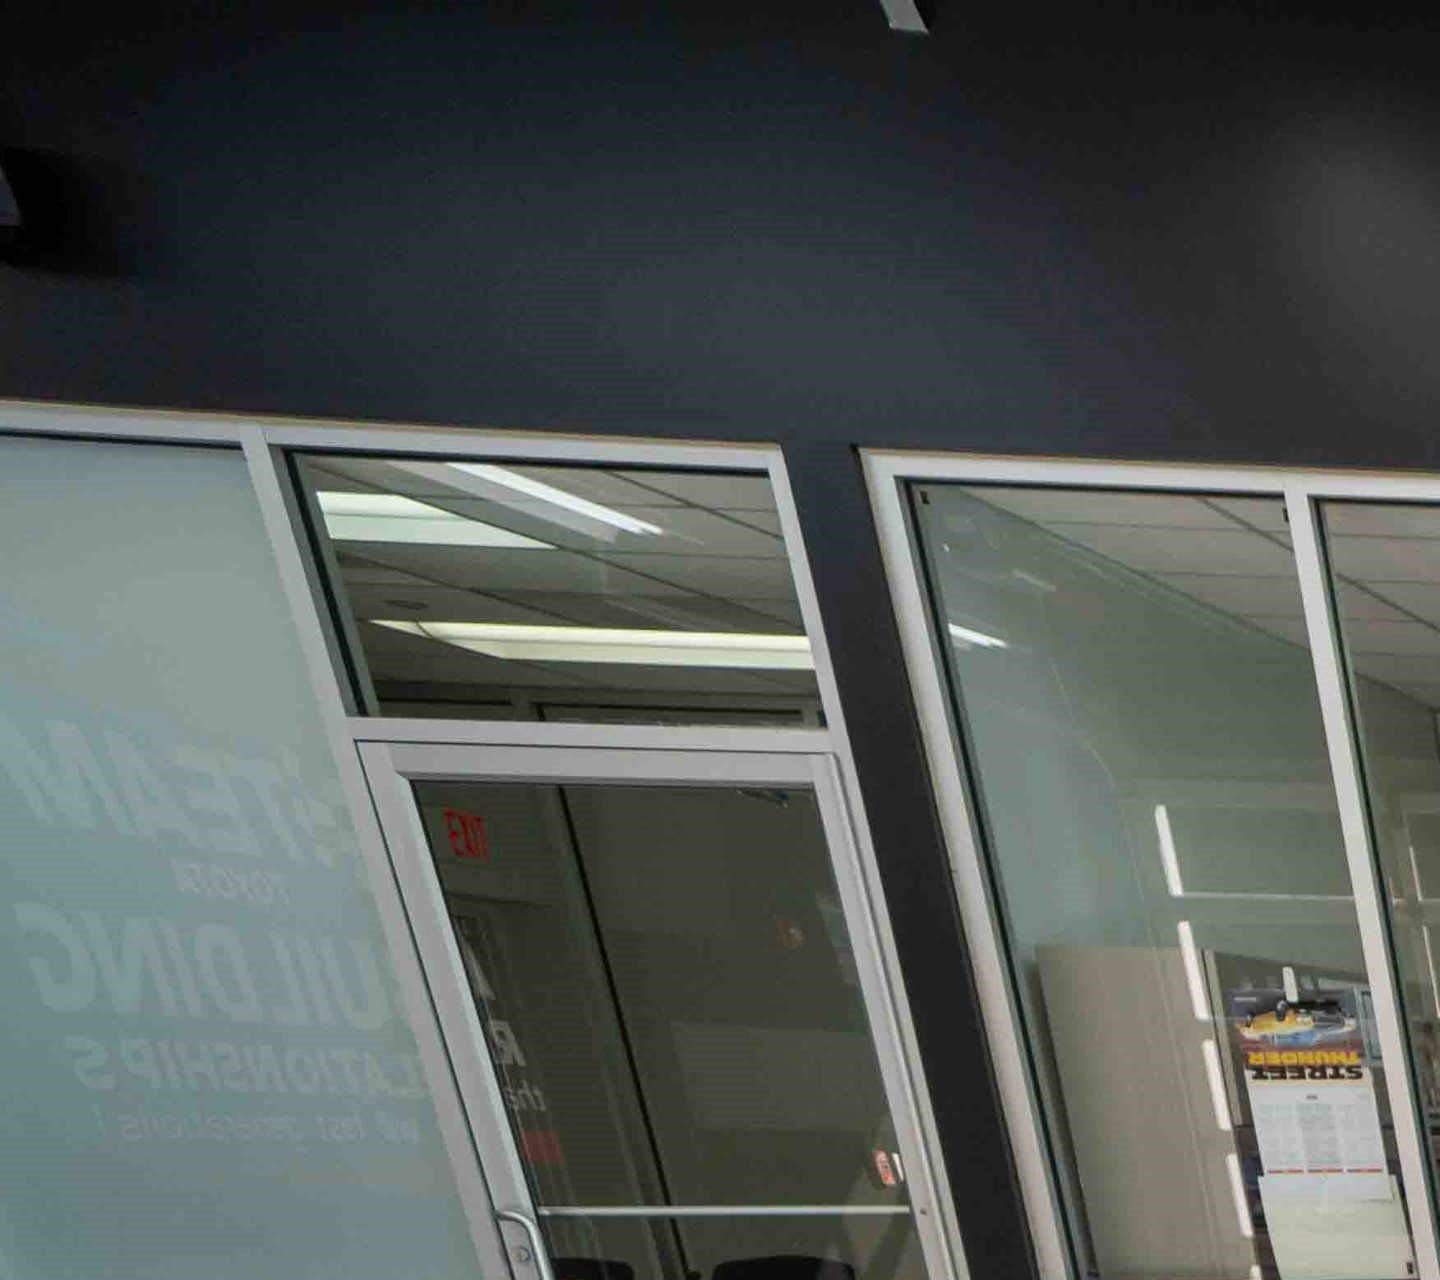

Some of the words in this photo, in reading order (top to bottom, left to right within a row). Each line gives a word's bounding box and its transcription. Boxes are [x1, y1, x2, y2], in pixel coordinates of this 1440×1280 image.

[445, 810, 490, 863] EXIT
[1248, 1050, 1360, 1066] THUNDER
[1252, 1065, 1364, 1081] STREET
